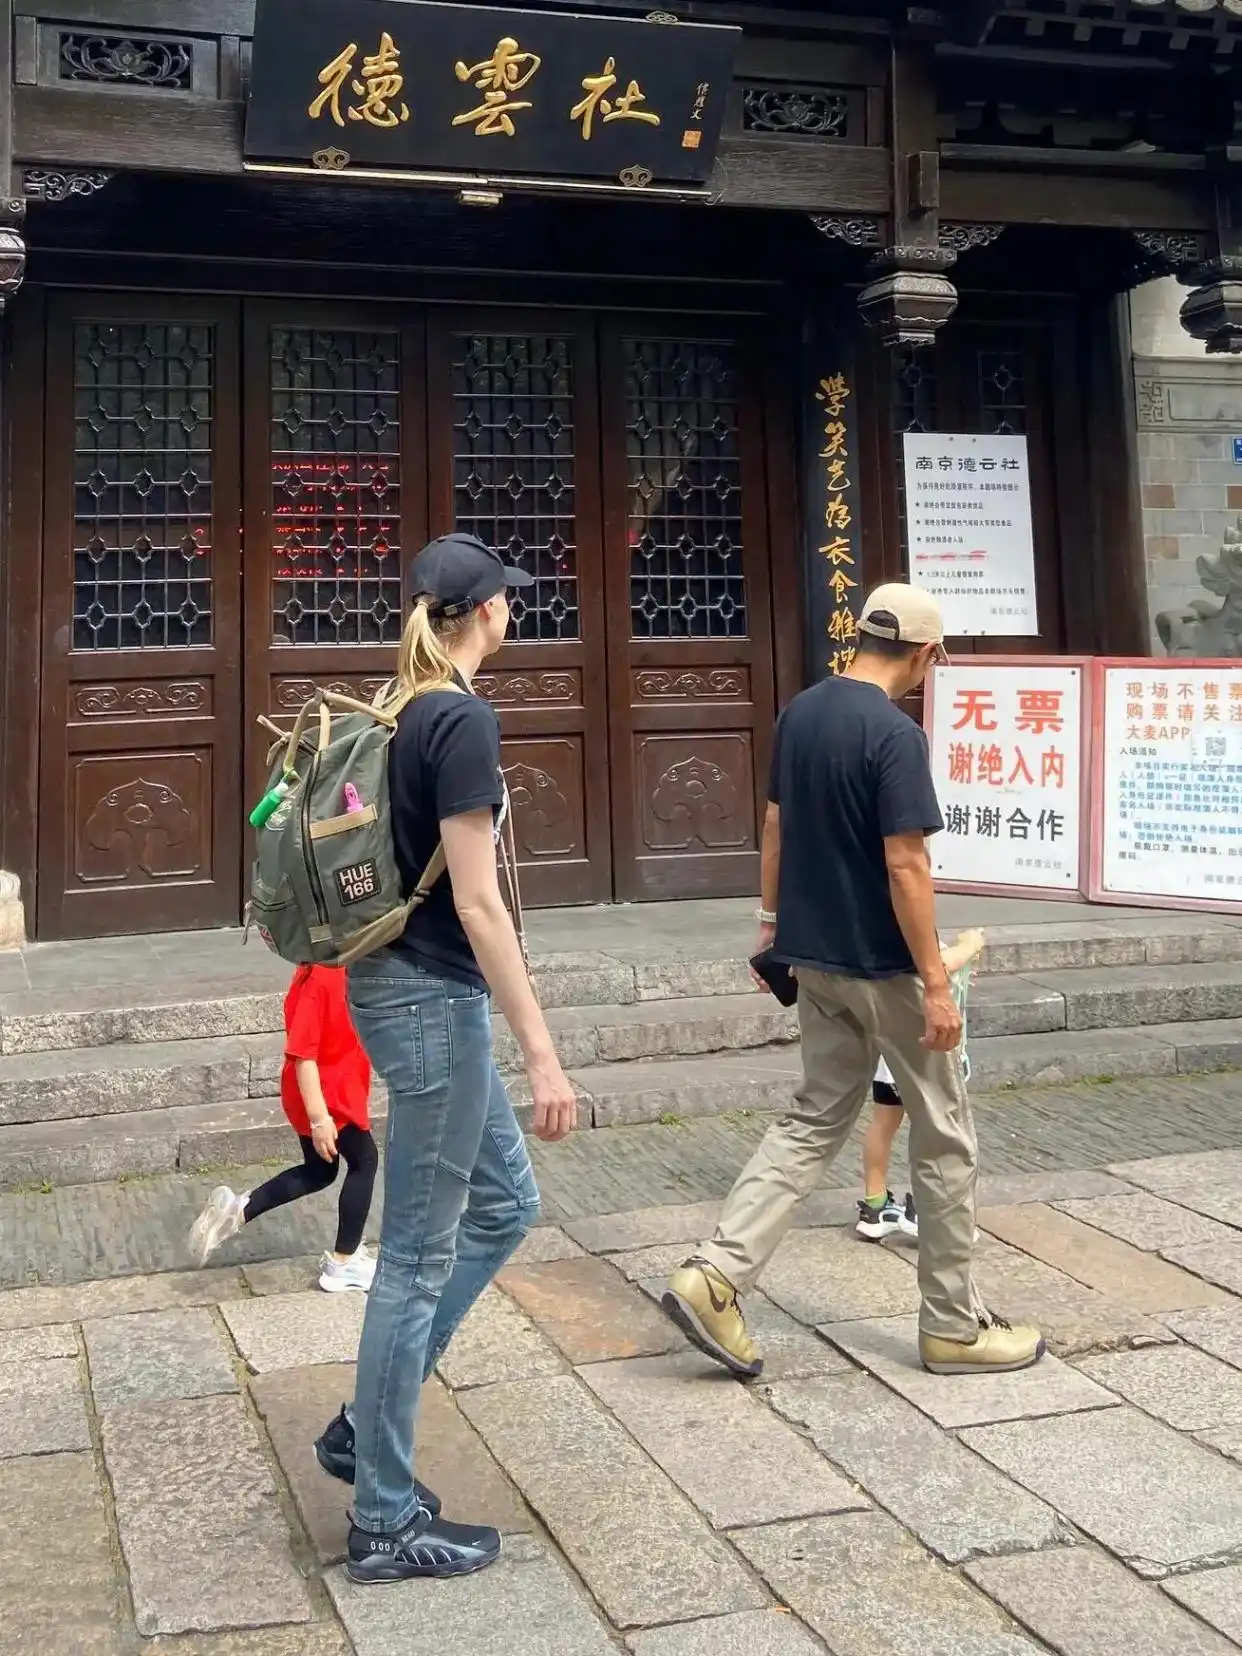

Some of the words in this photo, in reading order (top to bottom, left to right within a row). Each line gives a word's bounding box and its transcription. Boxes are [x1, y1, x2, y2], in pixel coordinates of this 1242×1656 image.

[915, 455, 1020, 472] 南京德云社
[1125, 682, 1242, 700] 现场不售票
[951, 690, 1064, 734] 无票
[1126, 703, 1242, 721] 购票请关注
[1126, 725, 1190, 740] 大麦APP
[1119, 747, 1157, 757] 入场须知
[948, 742, 1064, 789] 谢绝入内
[945, 804, 1064, 842] 谢谢合作
[340, 863, 373, 886] HUE
[344, 878, 374, 899] 166
